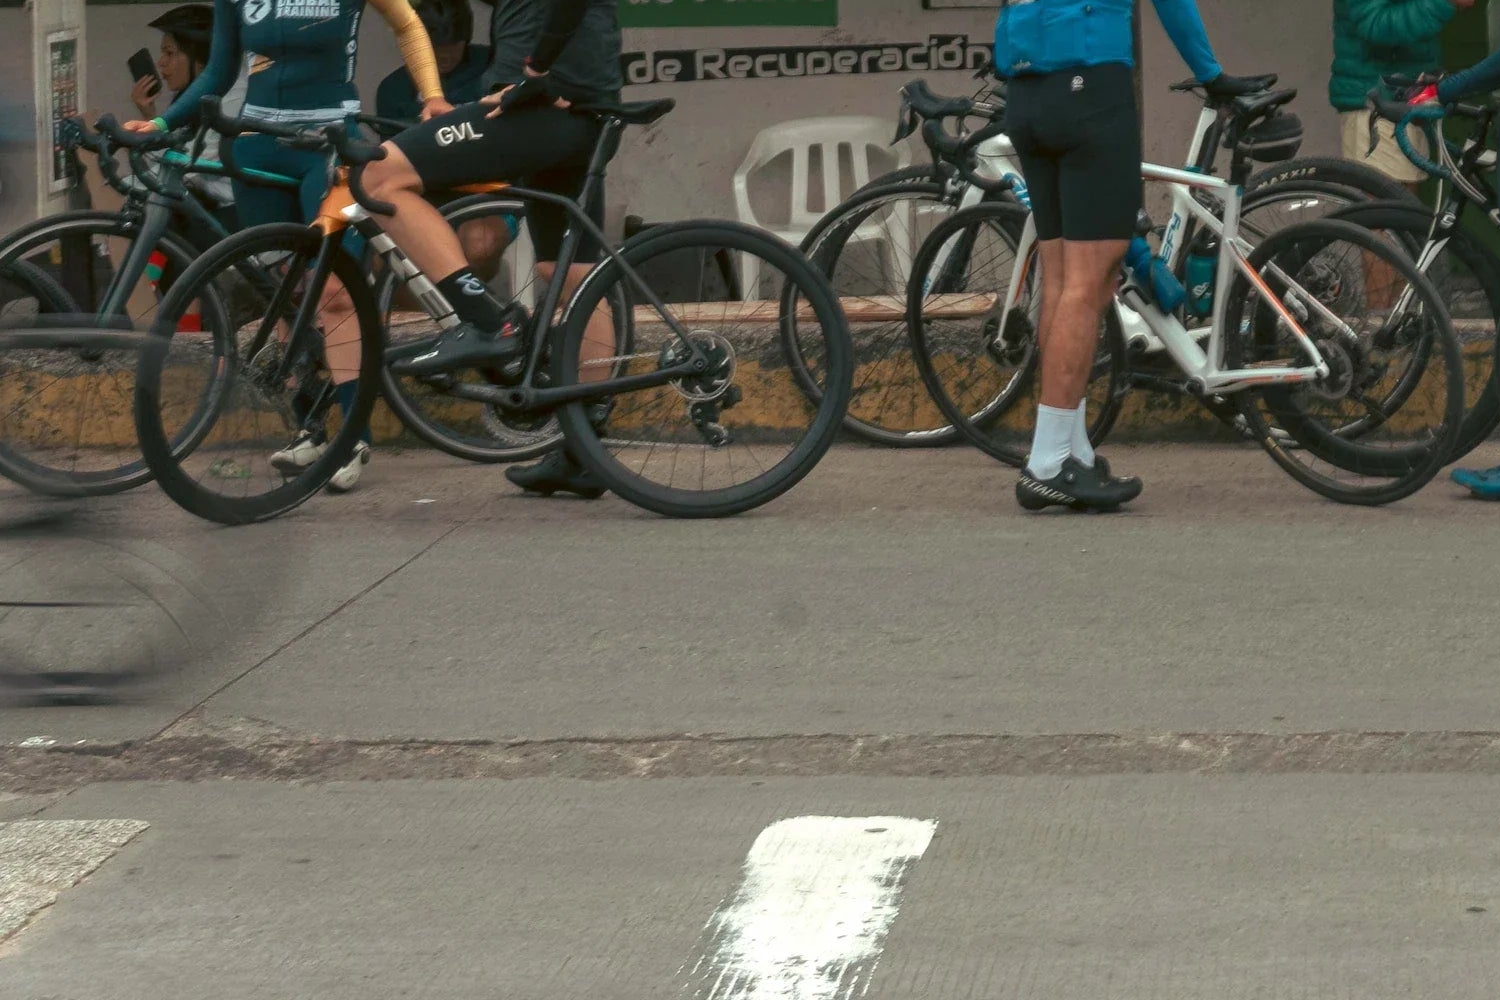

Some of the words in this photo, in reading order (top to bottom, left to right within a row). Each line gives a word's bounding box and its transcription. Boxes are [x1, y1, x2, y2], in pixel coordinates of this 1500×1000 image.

[275, 6, 340, 19] TRAINING
[627, 49, 683, 85] de
[694, 36, 993, 81] Recuperación
[435, 121, 484, 146] GVL
